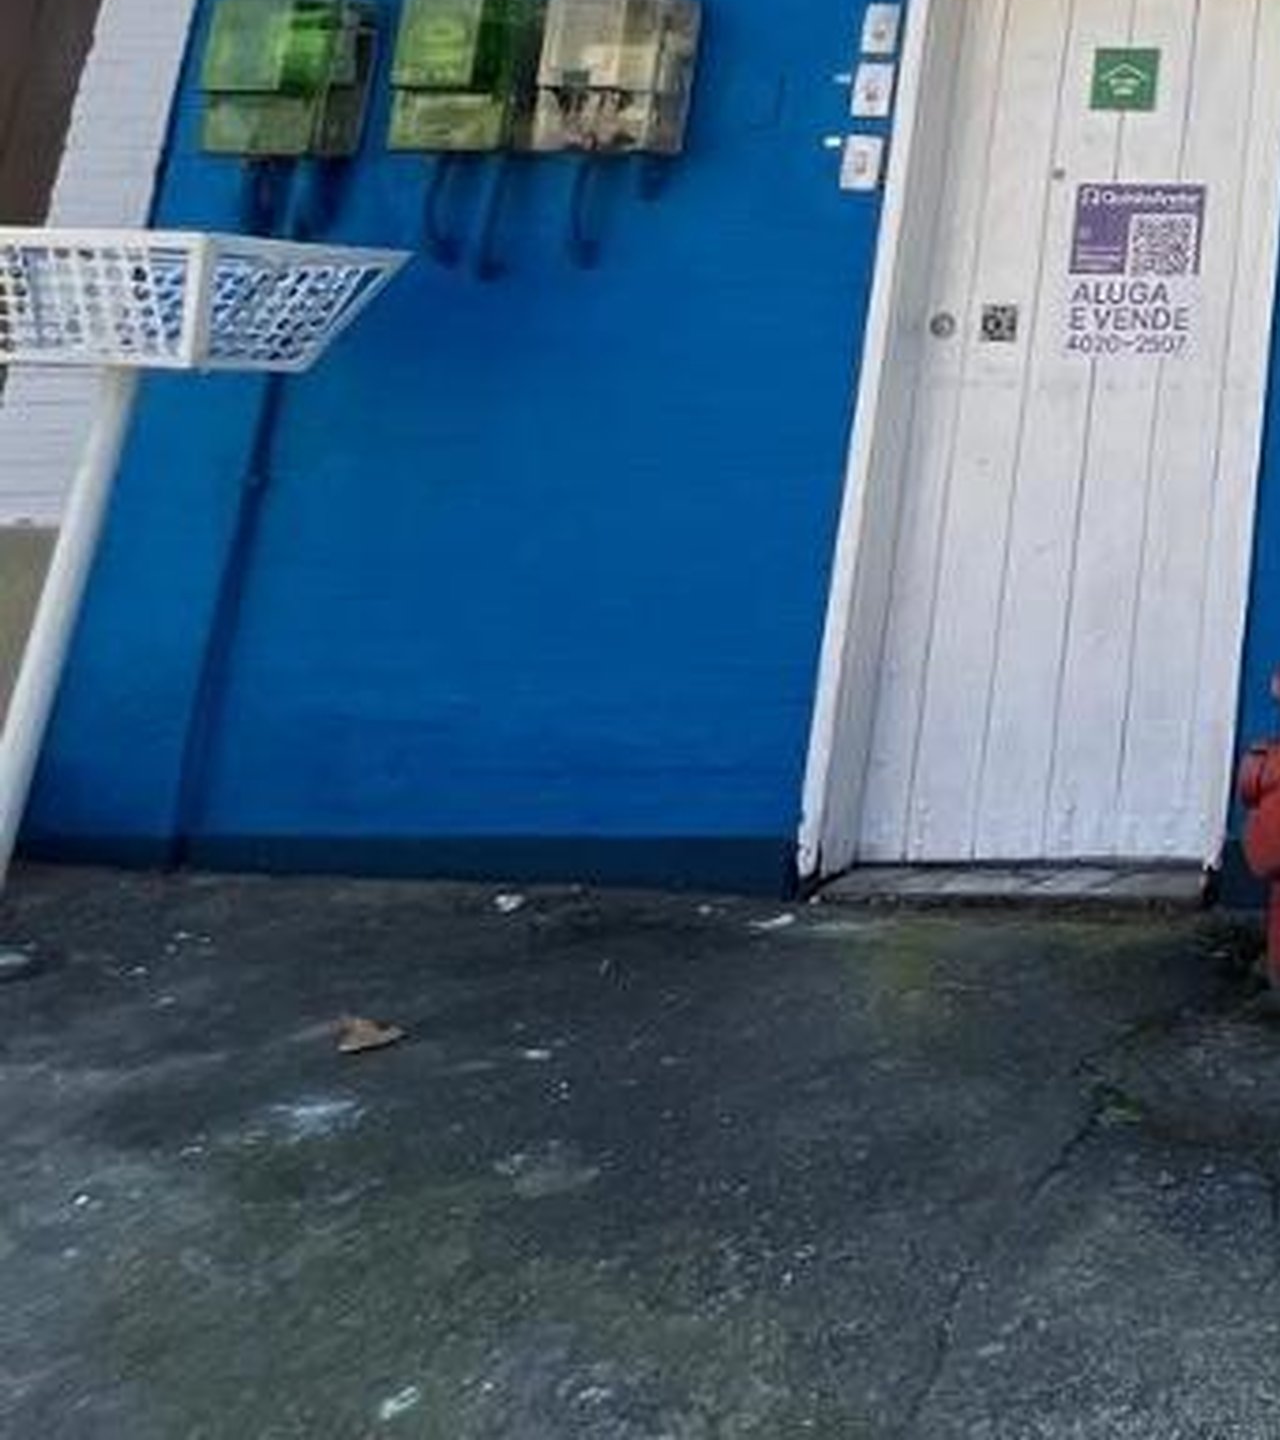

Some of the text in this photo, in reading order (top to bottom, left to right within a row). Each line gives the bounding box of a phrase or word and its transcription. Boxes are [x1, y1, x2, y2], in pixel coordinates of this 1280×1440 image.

[1071, 281, 1170, 305] ALUGA
[1068, 306, 1190, 330] E VENDE
